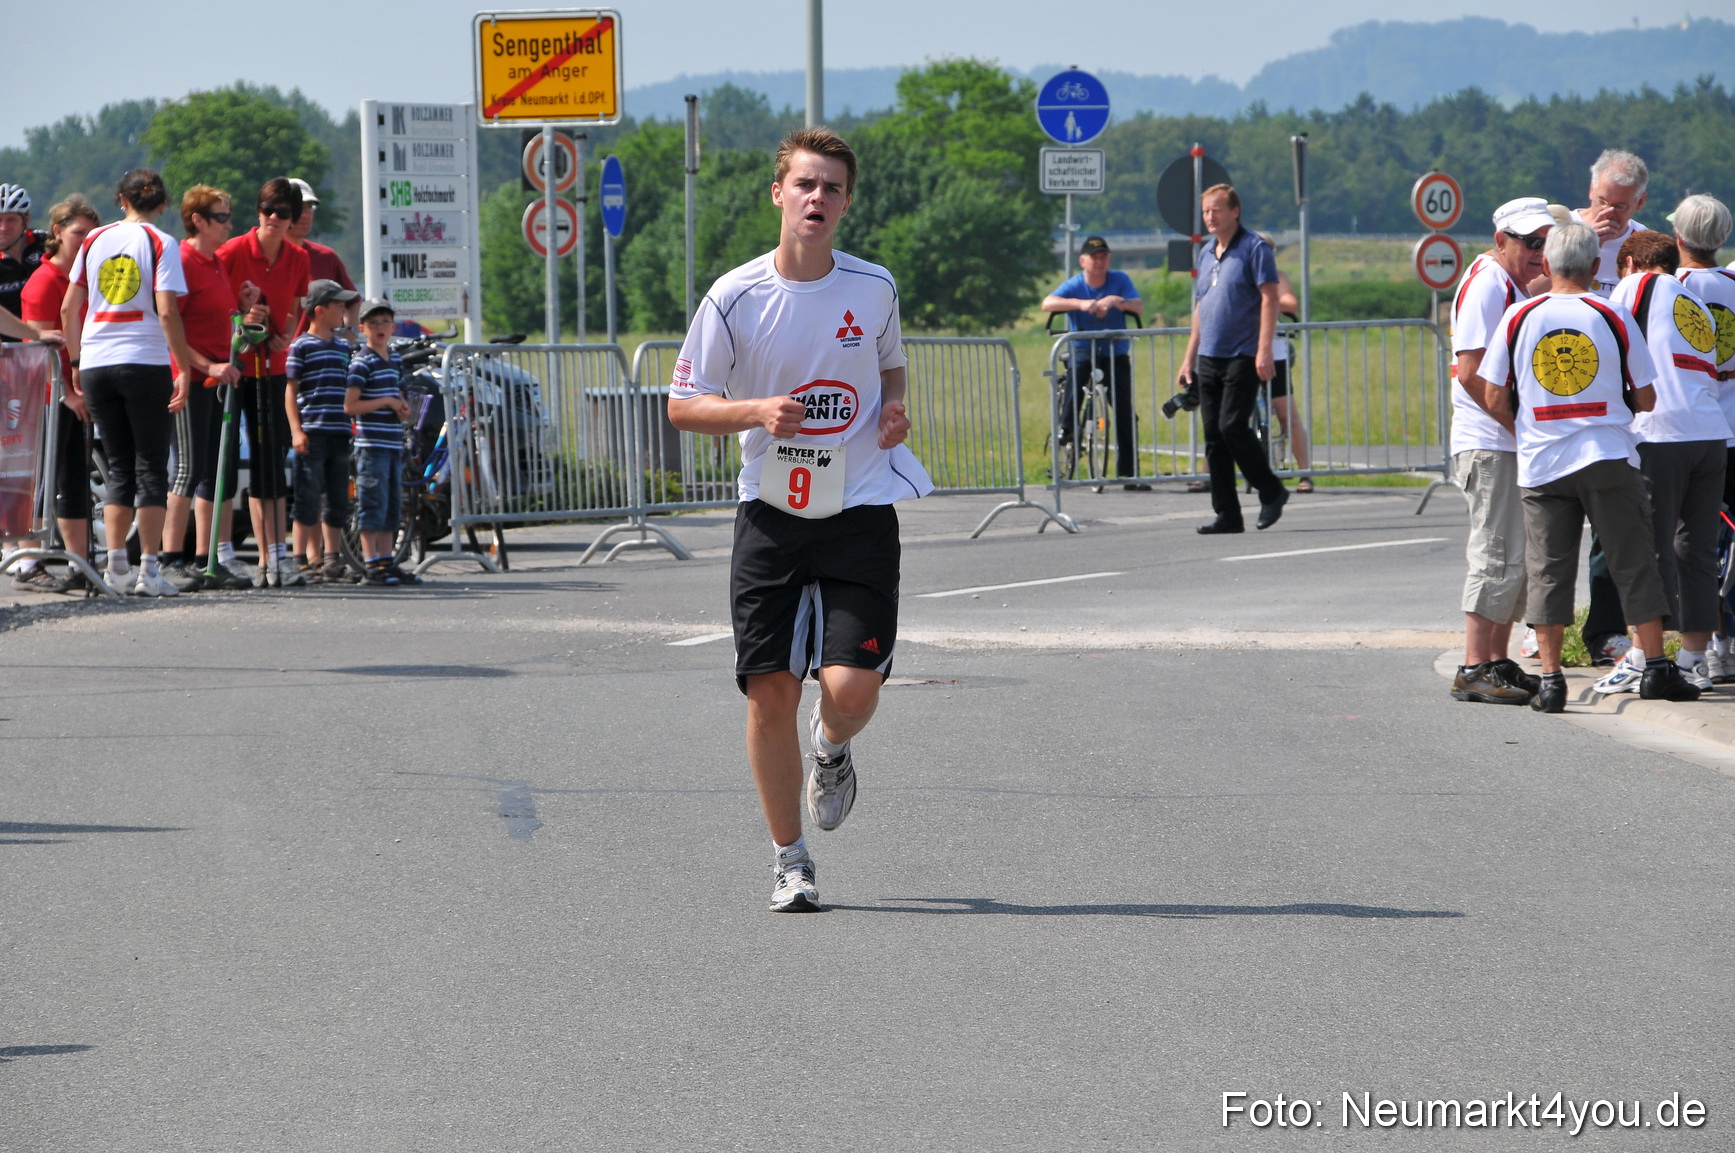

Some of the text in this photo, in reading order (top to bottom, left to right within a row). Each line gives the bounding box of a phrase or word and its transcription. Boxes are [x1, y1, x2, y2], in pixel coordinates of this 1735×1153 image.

[493, 30, 603, 62] Sengenthal
[508, 64, 589, 82] am Anger
[491, 93, 516, 106] Kreis
[520, 92, 569, 106] Neumarkt
[411, 106, 453, 122] HOLZAMMER
[412, 143, 455, 158] HOLZAMMER
[1052, 154, 1094, 164] Landwirt-
[1048, 166, 1097, 176] schaftlicher
[1048, 177, 1098, 187] Verkehr frei
[390, 181, 413, 207] SHB
[1426, 189, 1452, 214] 60
[391, 253, 427, 278] THULE
[1560, 336, 1569, 345] 12
[1571, 338, 1580, 348] 11
[1579, 346, 1589, 356] 10
[843, 396, 851, 405] &
[777, 446, 816, 458] MEYER
[777, 454, 815, 465] WERBUNG
[787, 467, 812, 510] 9
